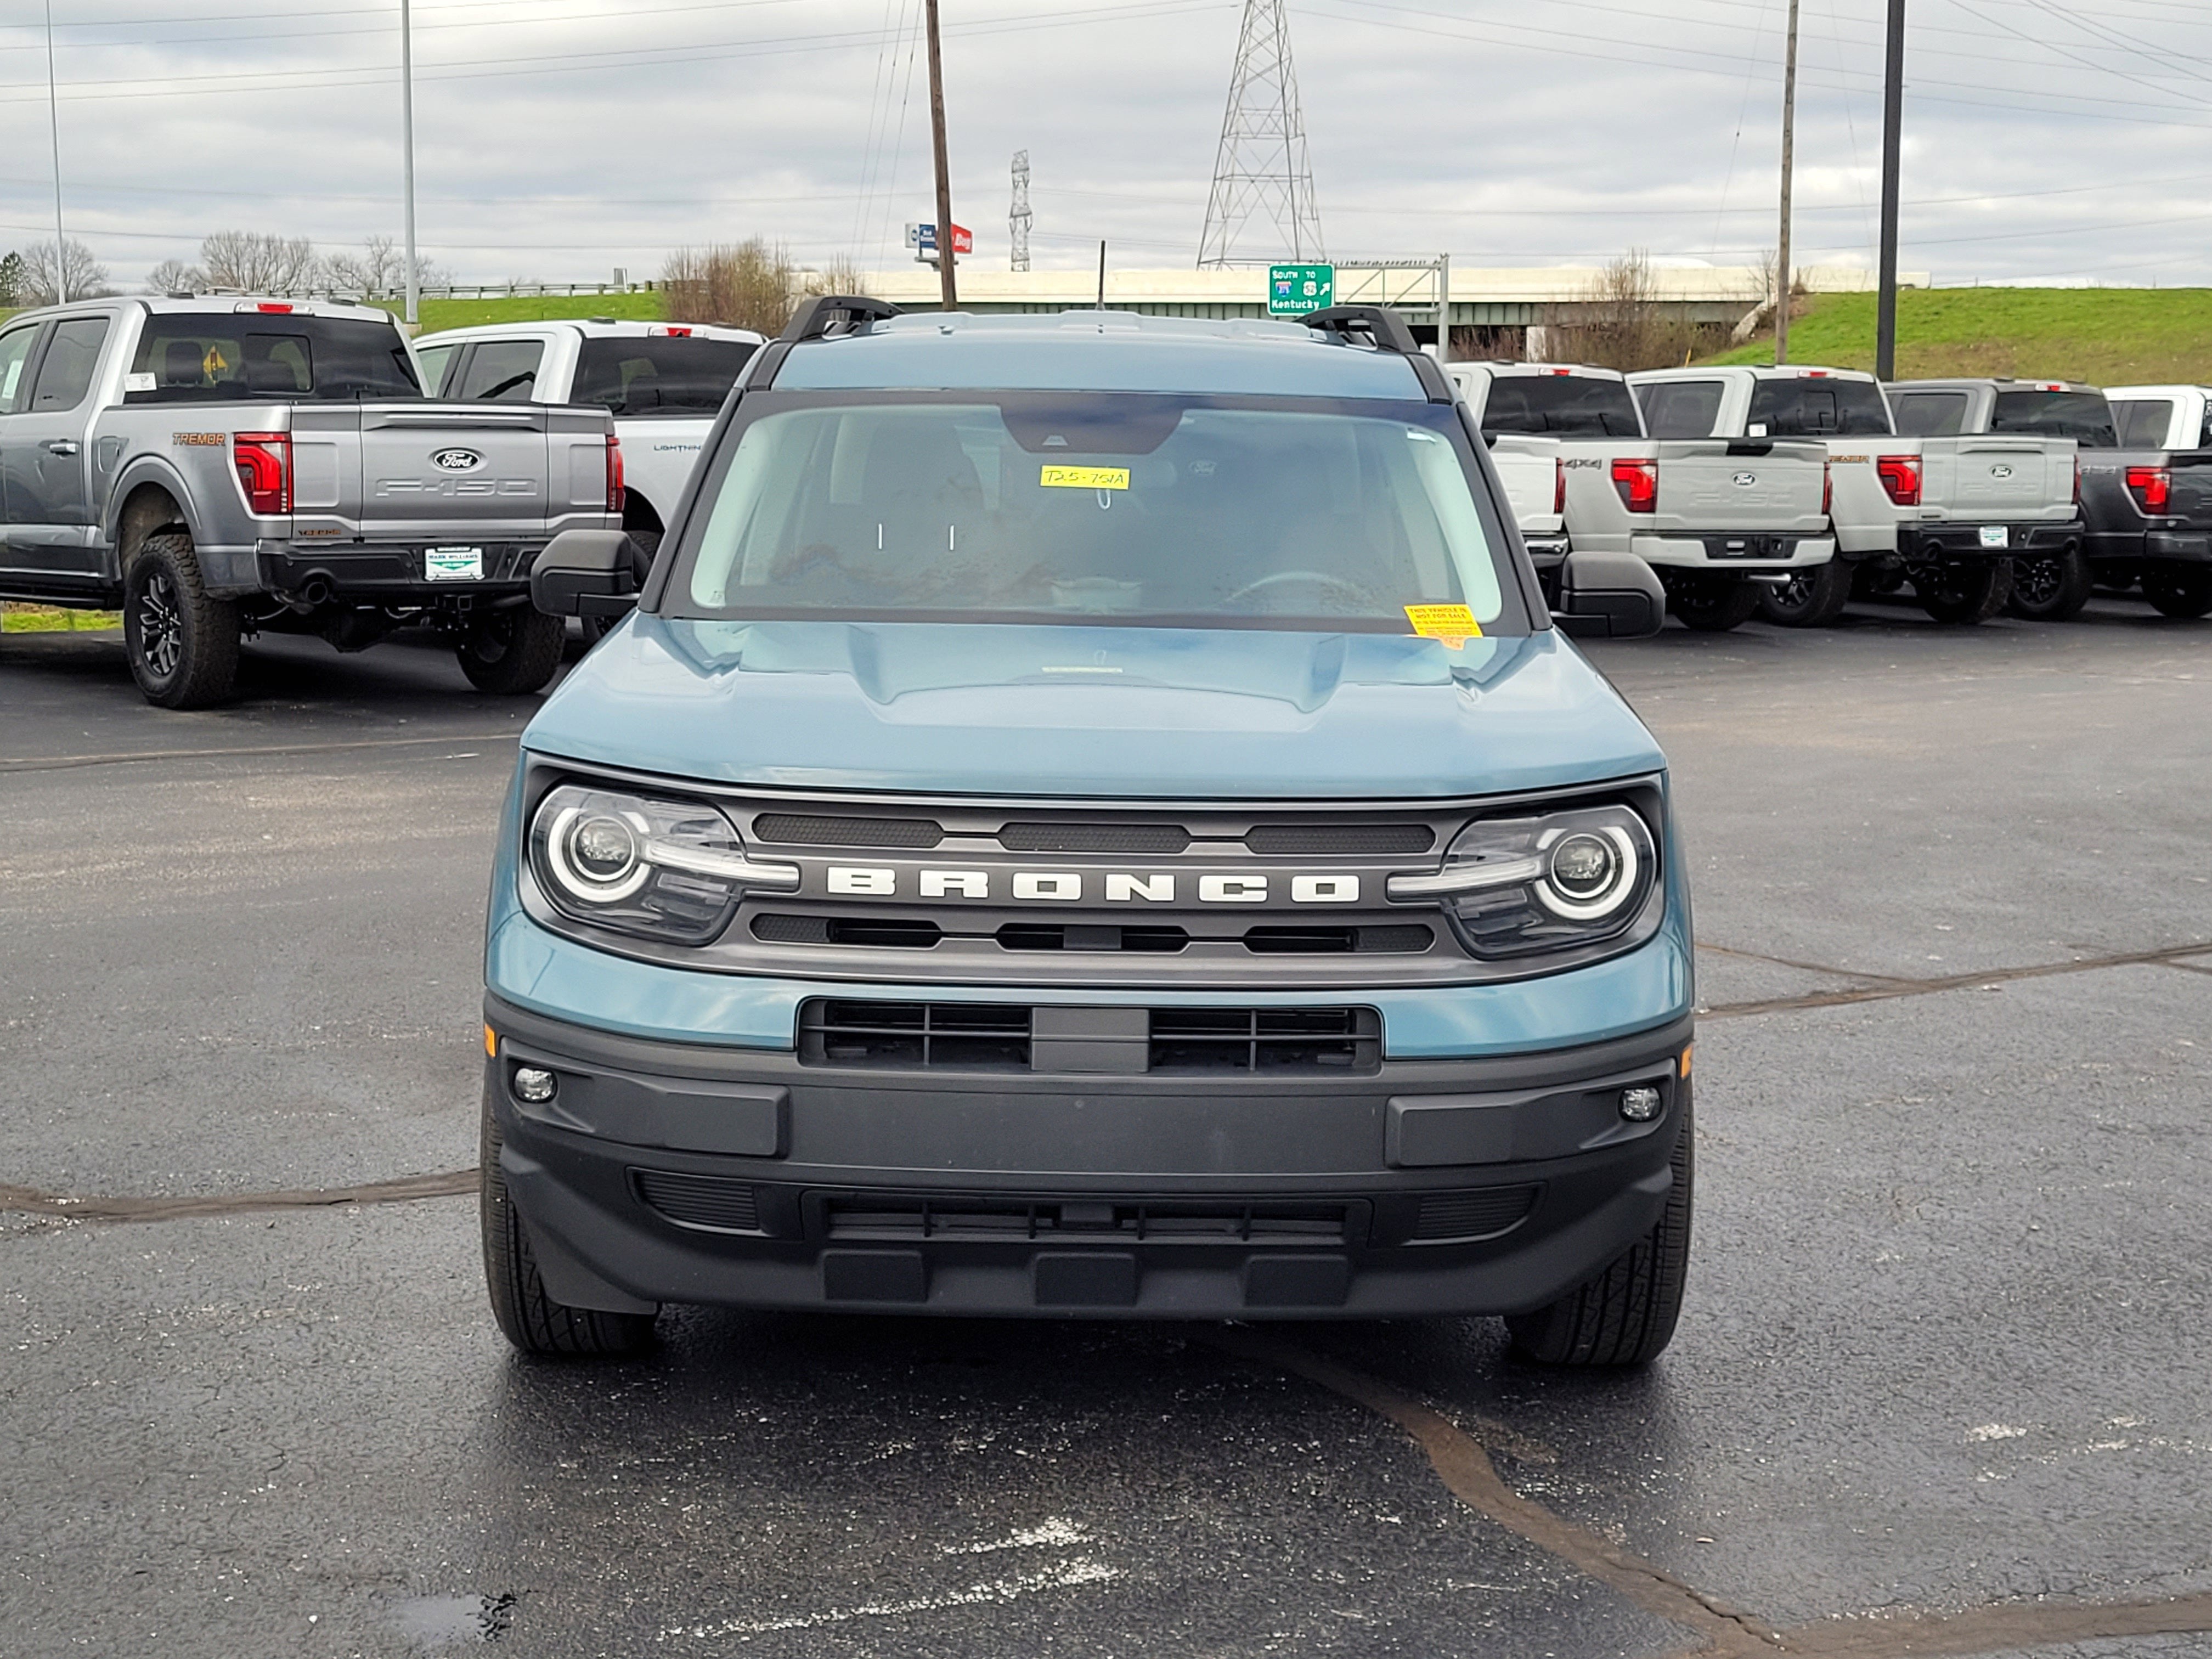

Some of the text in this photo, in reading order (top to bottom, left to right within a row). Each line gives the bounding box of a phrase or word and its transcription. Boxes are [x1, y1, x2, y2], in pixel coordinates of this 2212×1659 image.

[1272, 270, 1316, 279] SOUTH TO
[1272, 300, 1319, 311] Kentucky
[172, 432, 225, 446] TREMOR
[442, 453, 472, 467] Ford
[376, 478, 538, 496] F-150
[827, 866, 1359, 902] BRONCO
